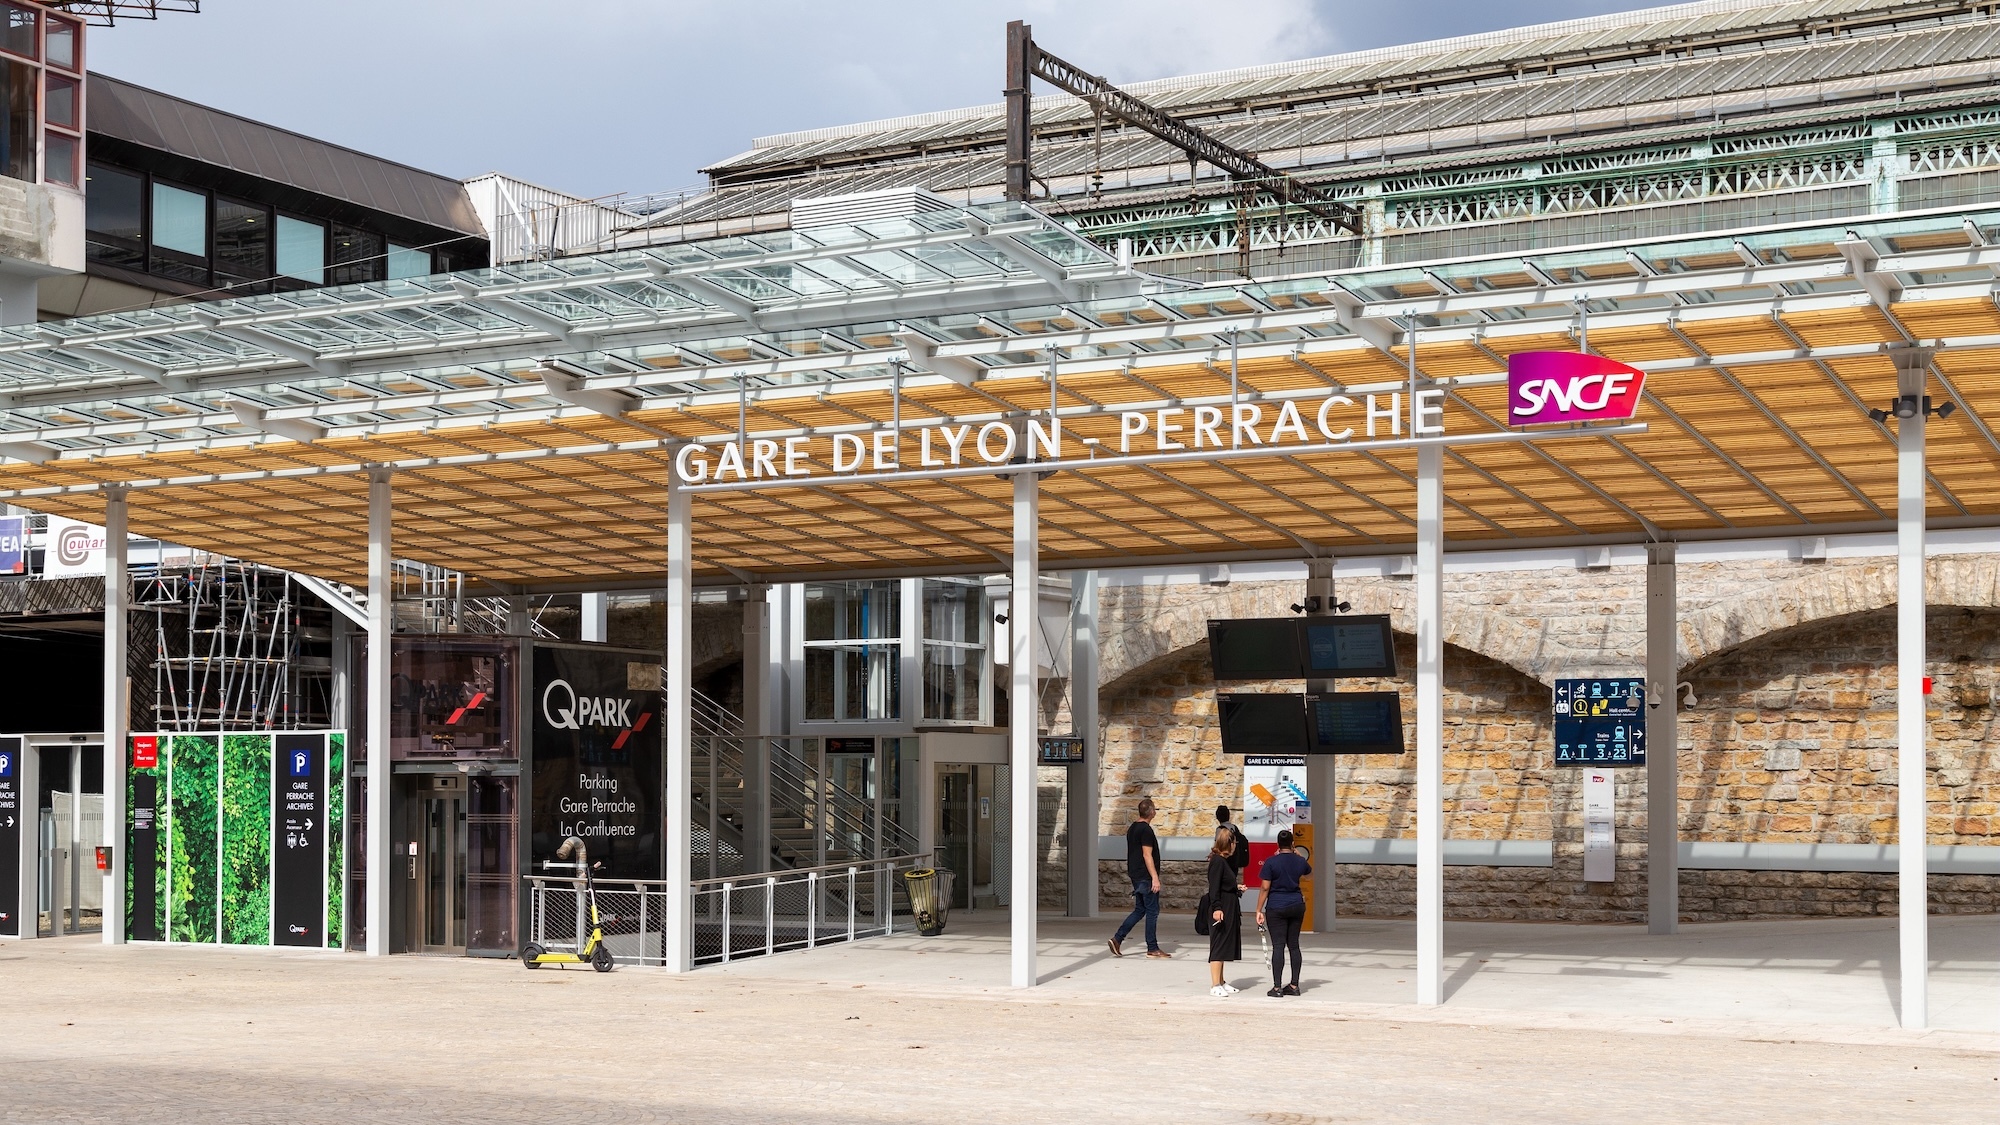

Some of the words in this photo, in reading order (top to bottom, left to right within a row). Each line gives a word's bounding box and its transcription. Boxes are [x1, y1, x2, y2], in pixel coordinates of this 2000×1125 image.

[1513, 373, 1636, 417] SNCF
[675, 436, 811, 483] GARE
[832, 430, 899, 473] DE
[921, 417, 1062, 467] LYON
[1120, 388, 1446, 453] PERRACHE
[0, 536, 20, 553] EA
[57, 525, 106, 566] Couvar
[543, 679, 633, 730] QPARK
[1560, 748, 1569, 758] A
[1597, 748, 1605, 758] 3
[1613, 748, 1627, 758] 23
[292, 782, 308, 790] GARE
[579, 773, 618, 794] Parking
[286, 792, 314, 800] PERRACHE
[286, 803, 314, 811] ARCHIVES
[560, 797, 588, 814] Gare
[591, 797, 636, 813] Perrache
[560, 821, 573, 837] La
[576, 820, 636, 837] Confluence
